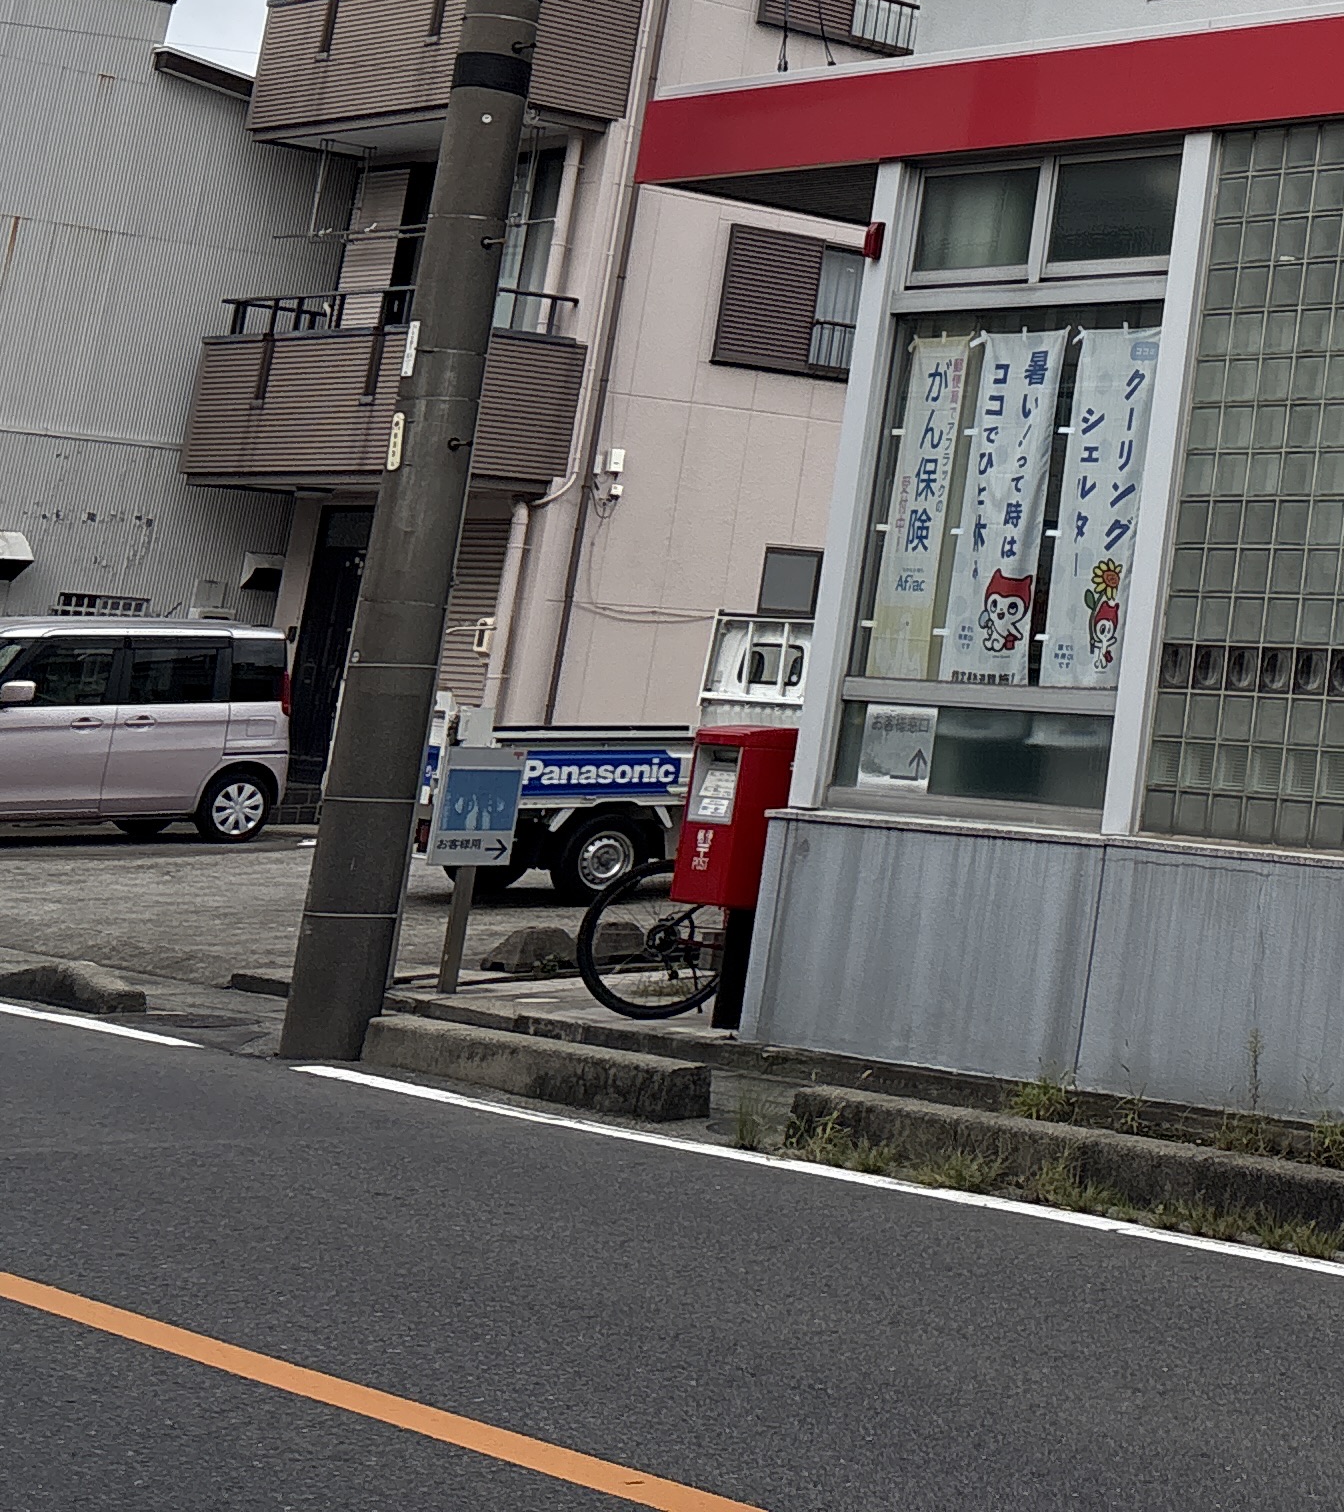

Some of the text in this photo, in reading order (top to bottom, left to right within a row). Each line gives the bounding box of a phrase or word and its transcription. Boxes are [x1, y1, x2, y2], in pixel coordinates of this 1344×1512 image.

[905, 359, 952, 552] がん保険
[1073, 408, 1105, 577] シェルター
[1103, 369, 1146, 552] クーリング
[521, 757, 676, 786] Panasonic
